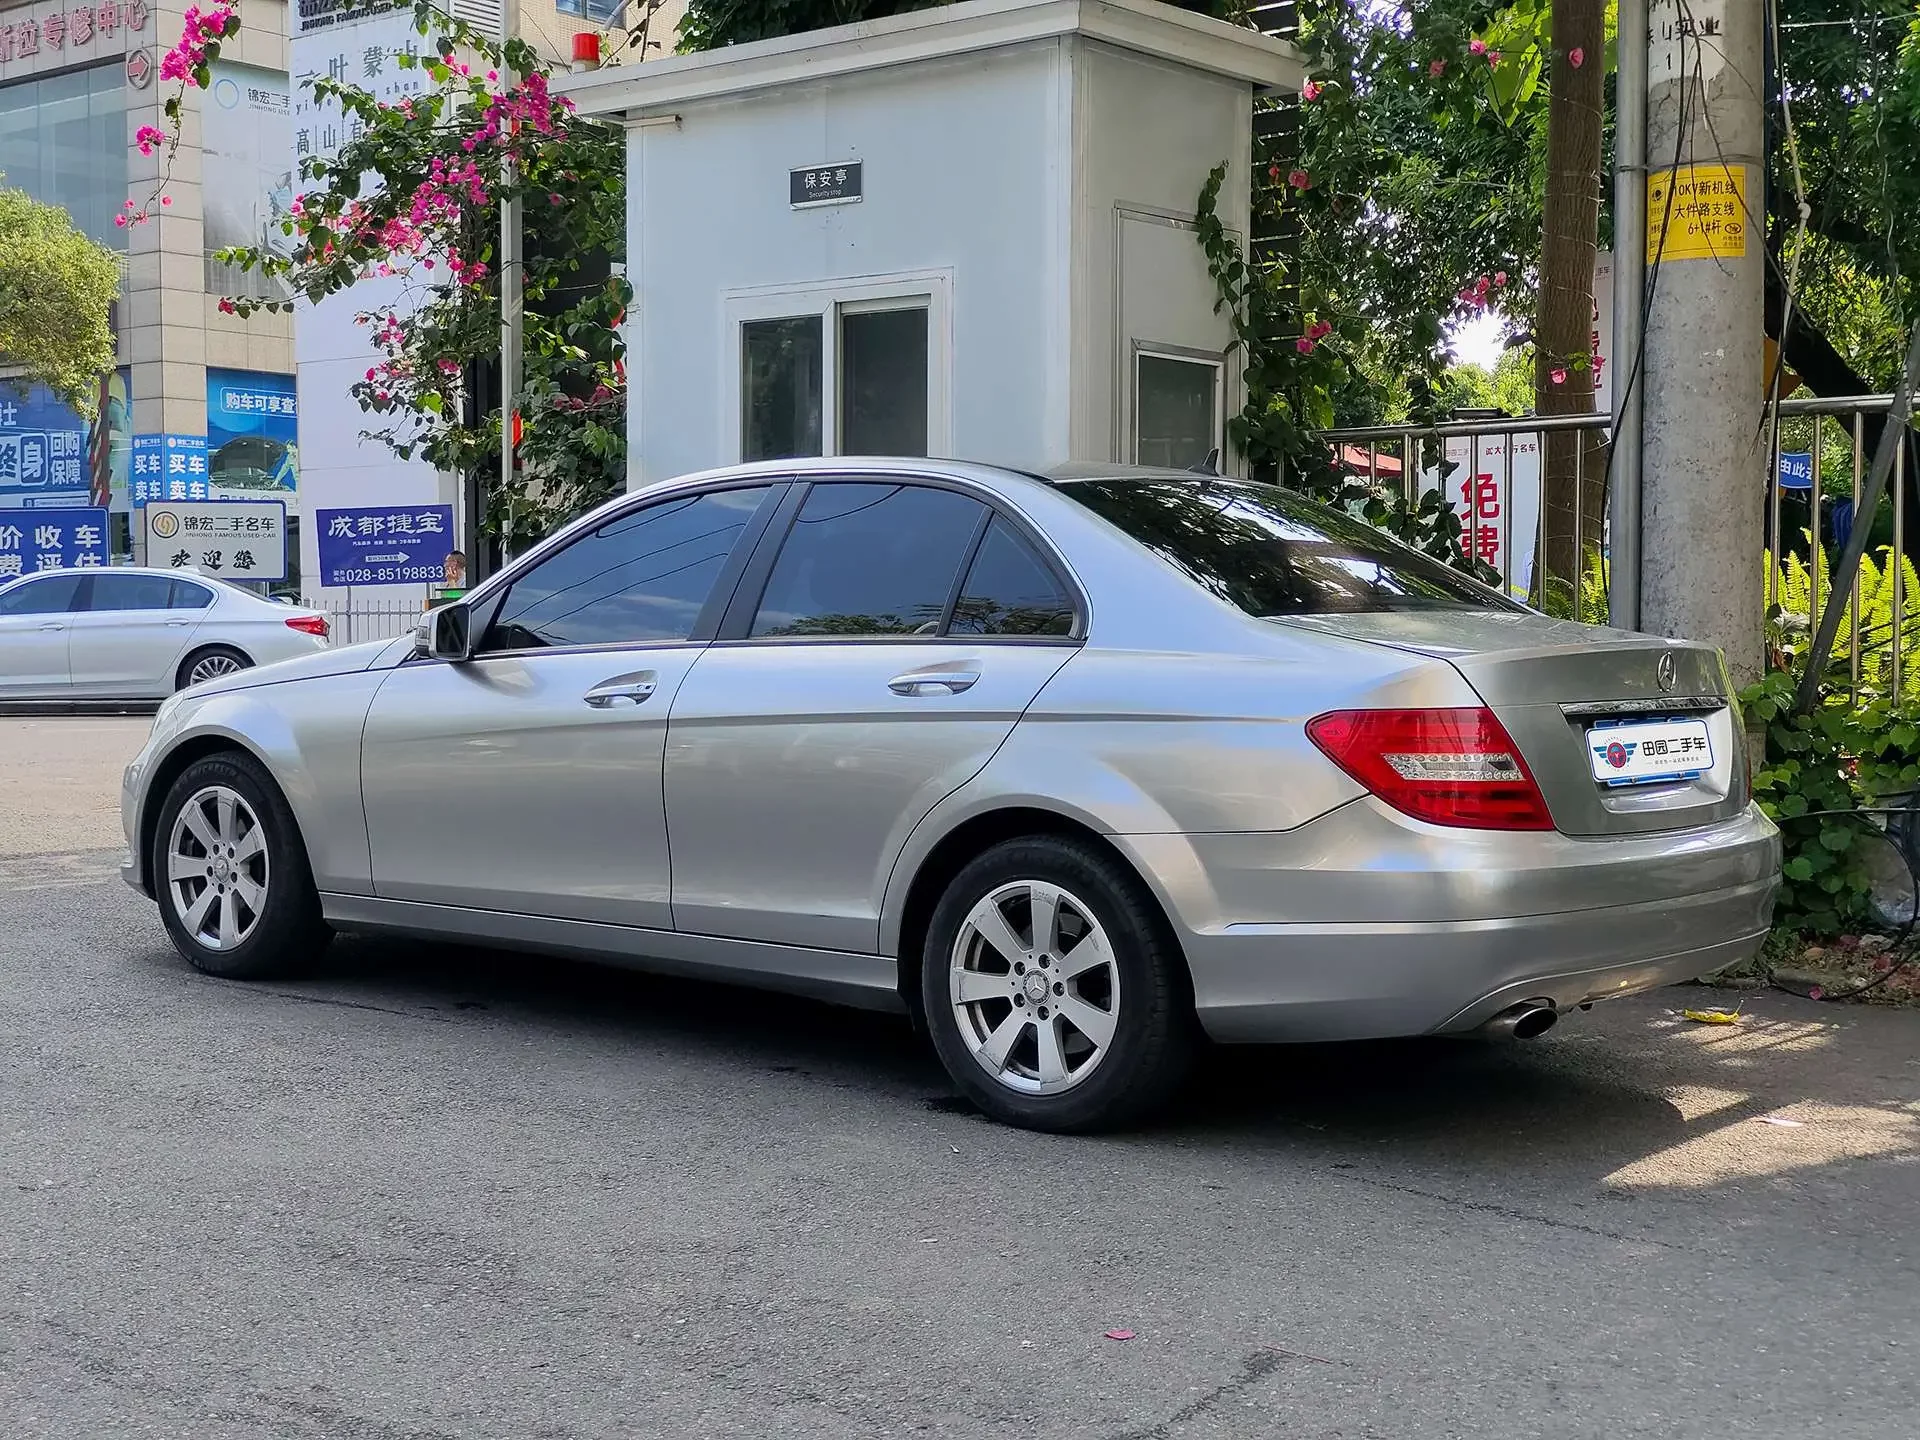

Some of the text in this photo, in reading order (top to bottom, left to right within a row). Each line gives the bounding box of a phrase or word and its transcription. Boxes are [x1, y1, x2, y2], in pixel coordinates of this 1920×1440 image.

[301, 15, 335, 31] JINHONG
[336, 7, 371, 23] FAMOUS
[805, 168, 847, 189] 保安亭
[1674, 201, 1735, 220] 大件路支线
[226, 392, 297, 414] 购车可享查
[50, 459, 80, 485] 保障
[135, 453, 161, 474] 买车
[169, 454, 206, 475] 买车
[135, 480, 161, 500] 卖车
[169, 480, 206, 500] 卖车
[183, 516, 275, 531] 锦宏二手名车
[328, 511, 444, 538] 成都捷宝
[170, 548, 257, 571] 欢迎您
[346, 565, 444, 583] 028-85198833
[1642, 736, 1706, 756] 田园二手车
